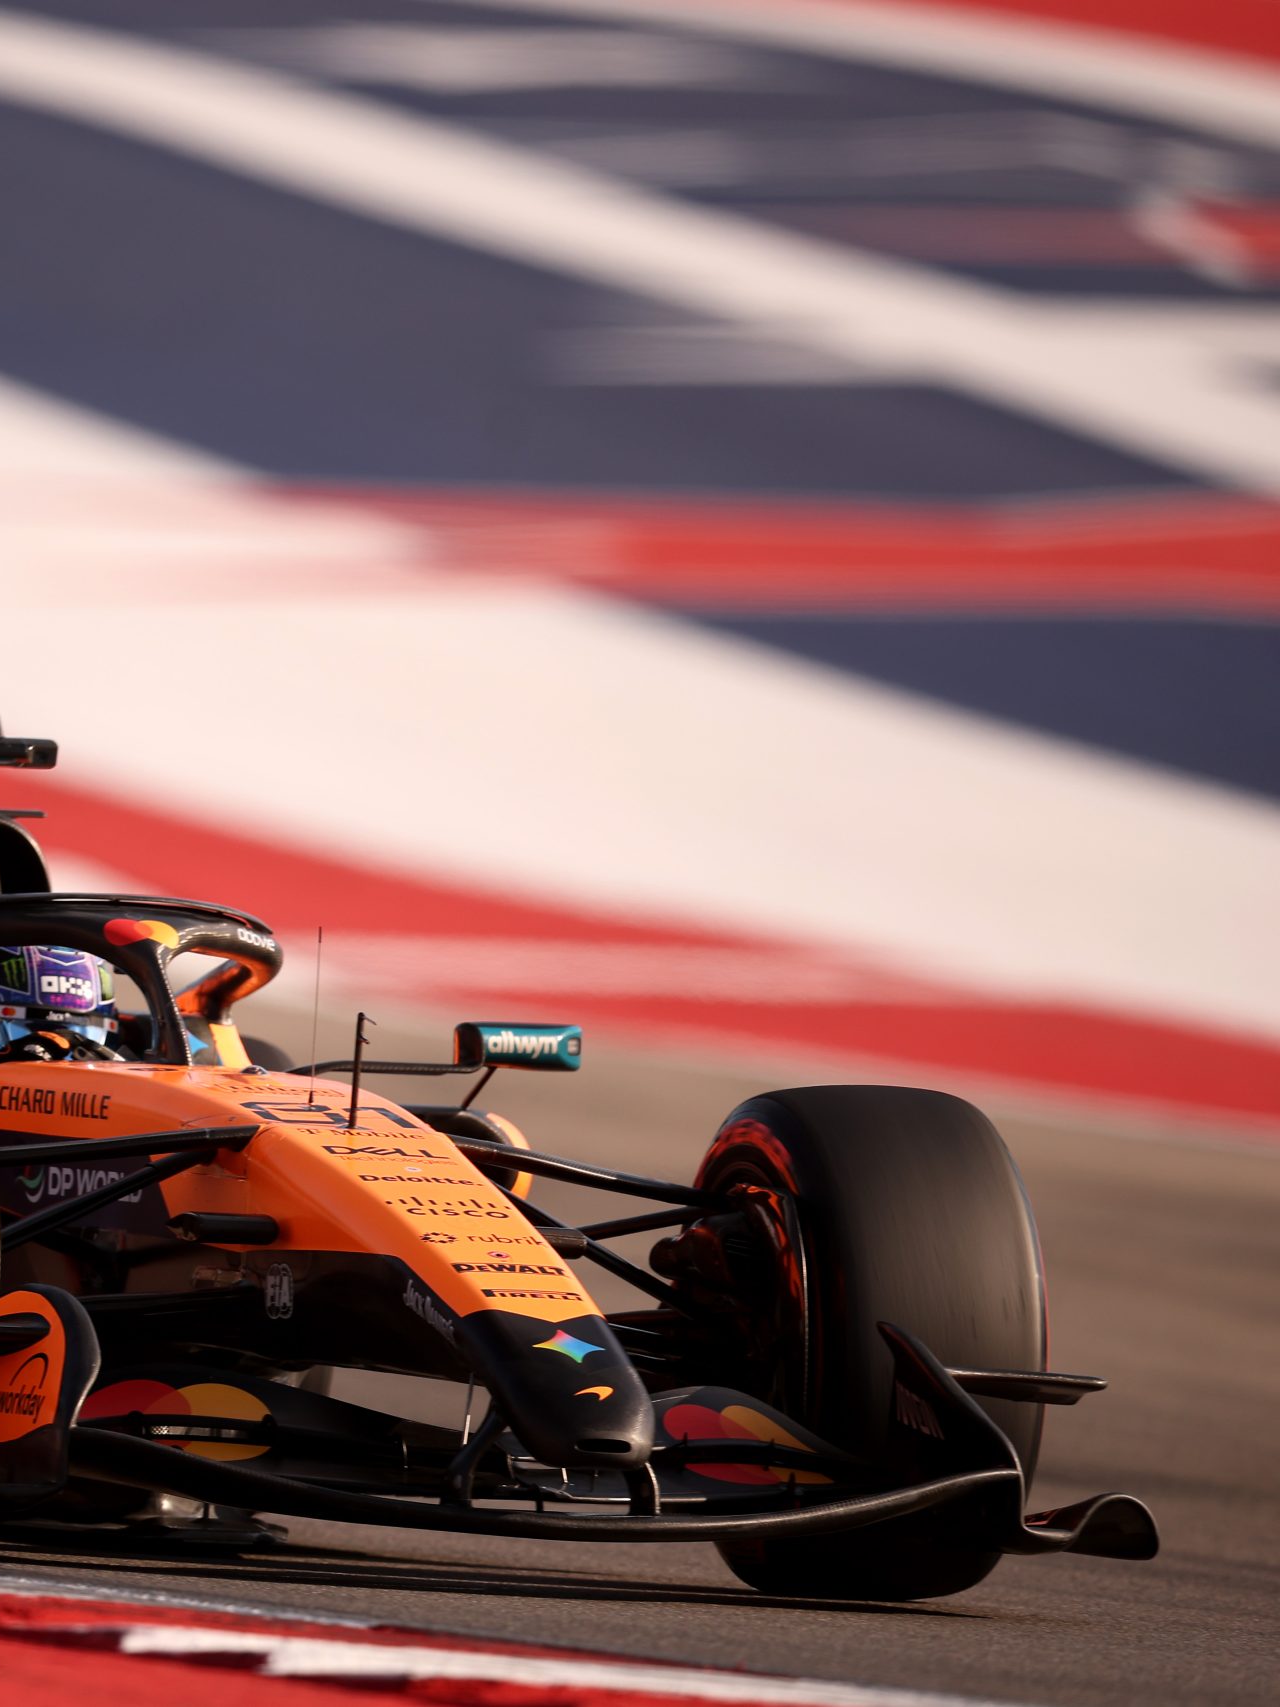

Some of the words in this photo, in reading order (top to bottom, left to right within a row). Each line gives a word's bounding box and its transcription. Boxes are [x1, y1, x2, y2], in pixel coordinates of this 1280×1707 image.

[40, 975, 93, 999] OKX
[487, 1030, 559, 1059] allwyn
[60, 1091, 111, 1120] MILLE
[322, 1145, 450, 1160] DELL
[47, 1166, 74, 1197] DP
[466, 1232, 546, 1248] rubrik
[480, 1288, 584, 1303] PIRELLI
